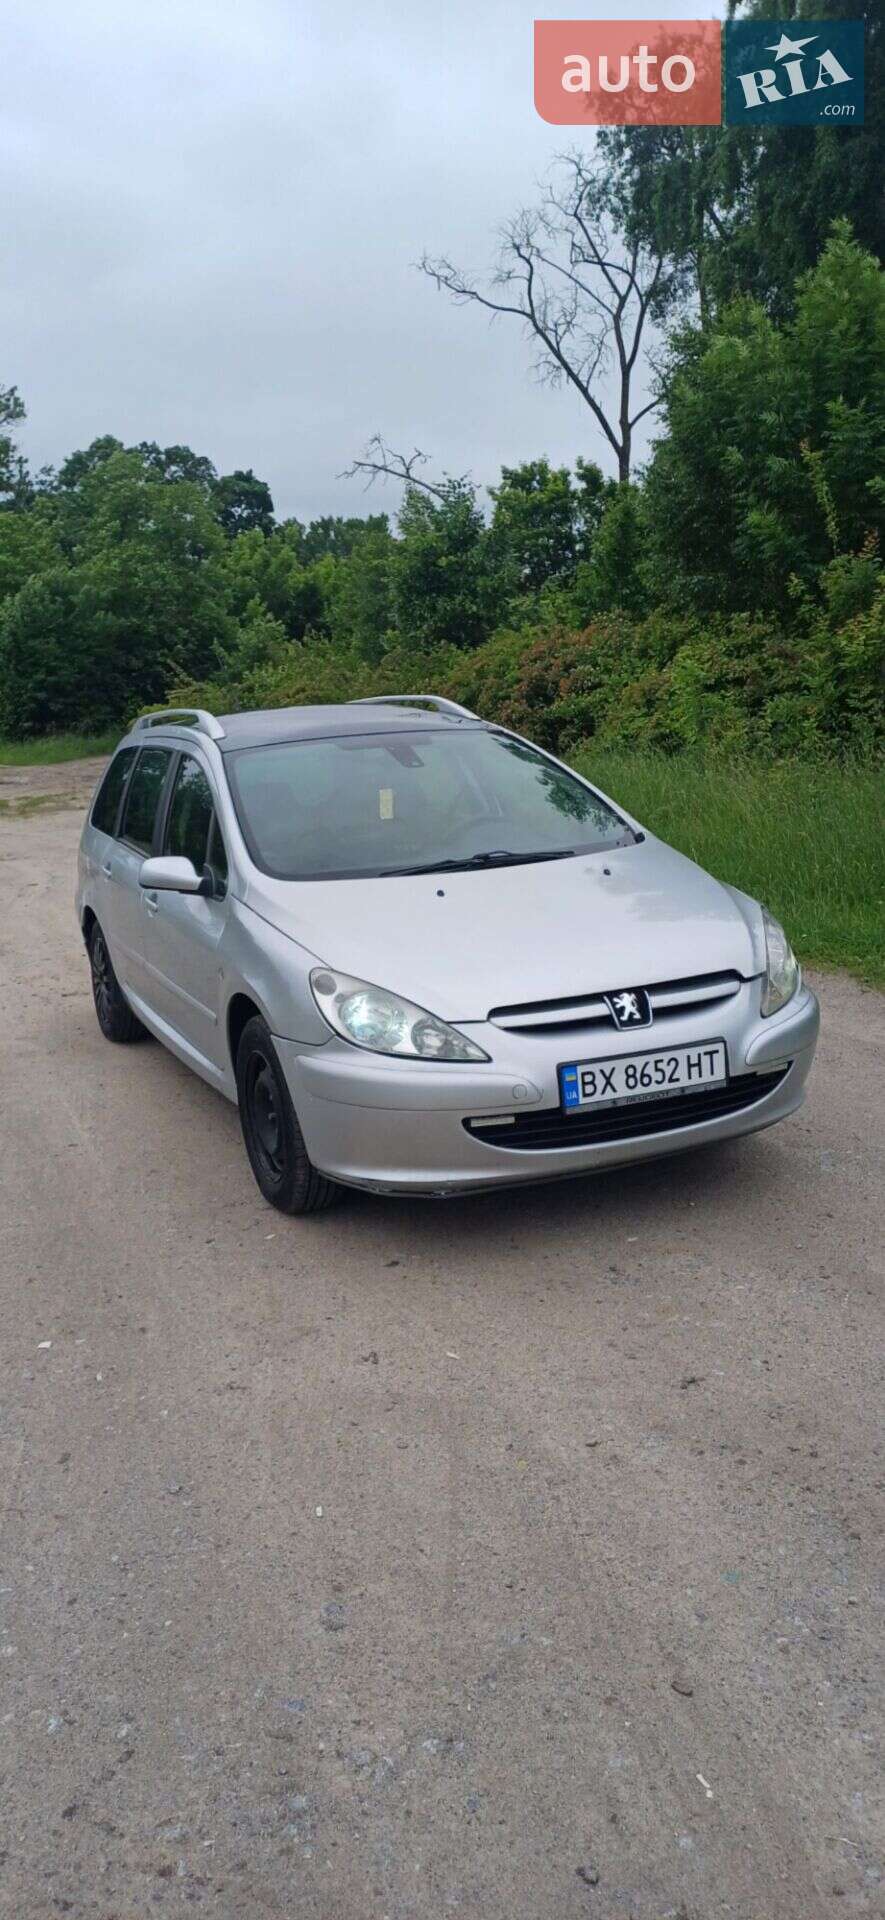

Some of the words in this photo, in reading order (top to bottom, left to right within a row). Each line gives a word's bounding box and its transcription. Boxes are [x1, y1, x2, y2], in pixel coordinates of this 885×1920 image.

[581, 1067, 617, 1098] BX
[625, 1057, 680, 1090] 8652
[687, 1050, 719, 1080] HT
[566, 1091, 578, 1100] UA
